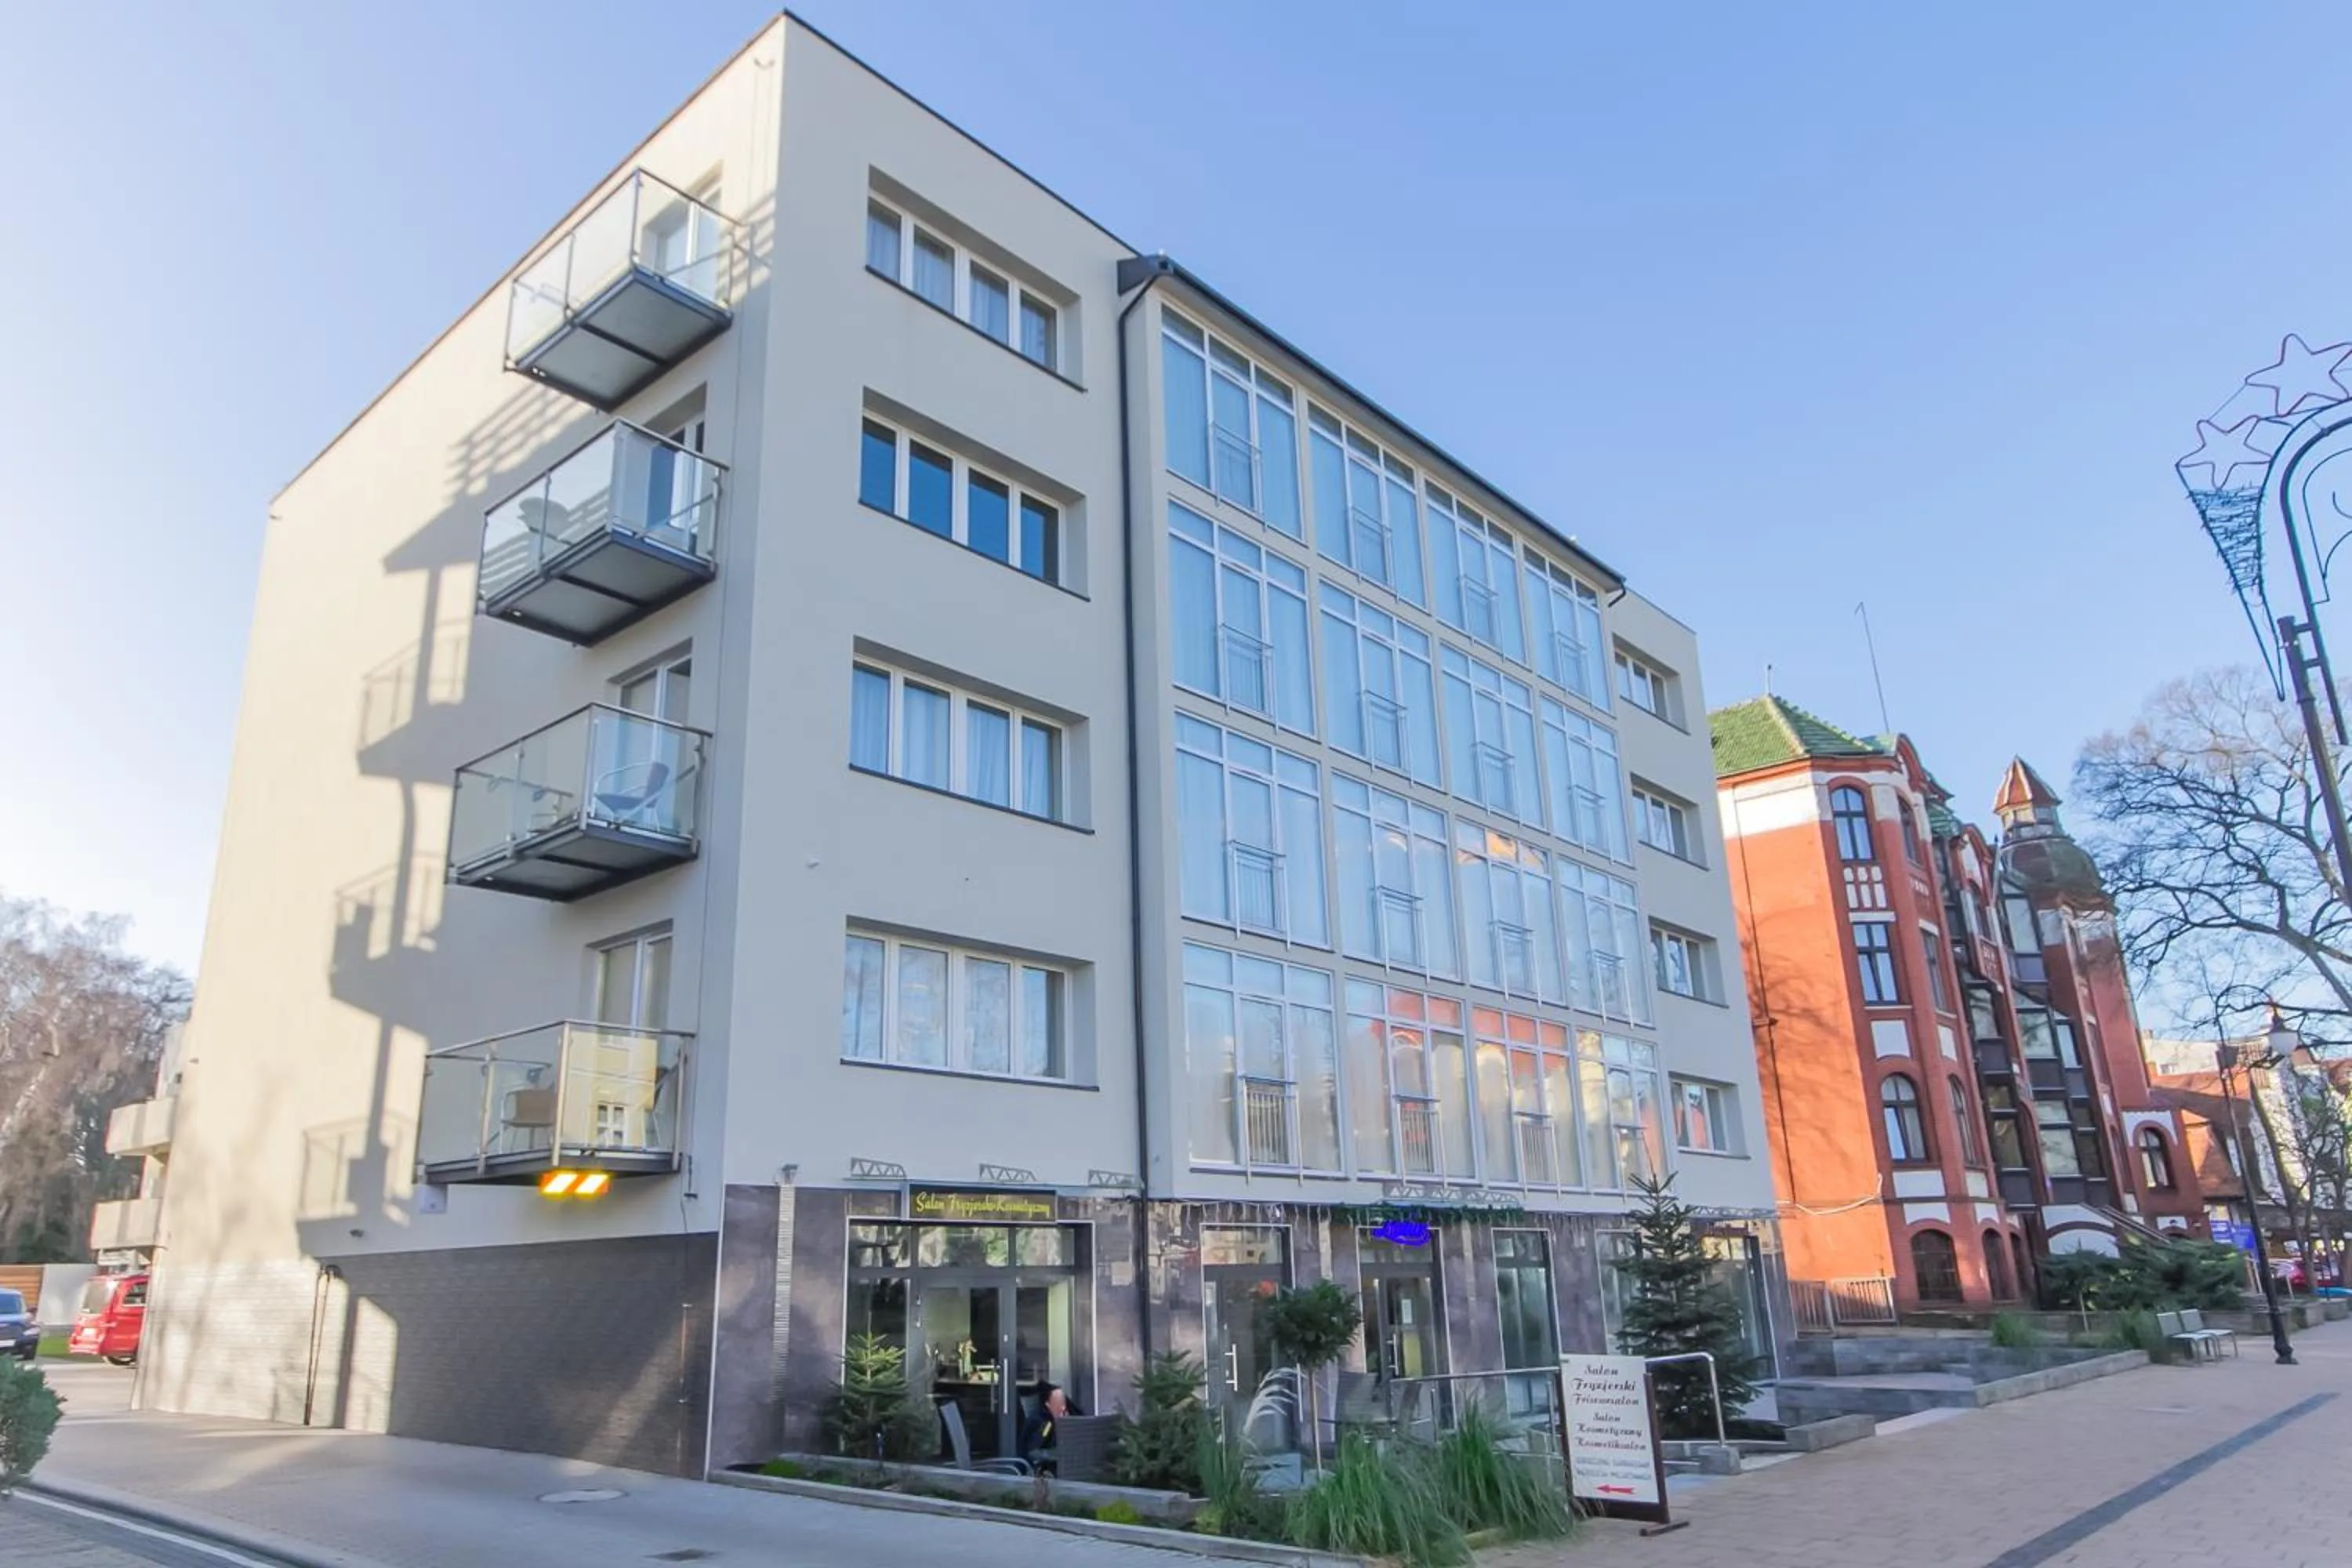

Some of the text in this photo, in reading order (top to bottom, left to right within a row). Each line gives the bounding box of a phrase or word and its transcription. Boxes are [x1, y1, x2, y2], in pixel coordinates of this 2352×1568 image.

[916, 1191, 944, 1212] Salon
[1584, 1364, 1618, 1375] Salon
[1573, 1377, 1635, 1392] Fryzjerski
[1593, 1412, 1621, 1422] Salon
